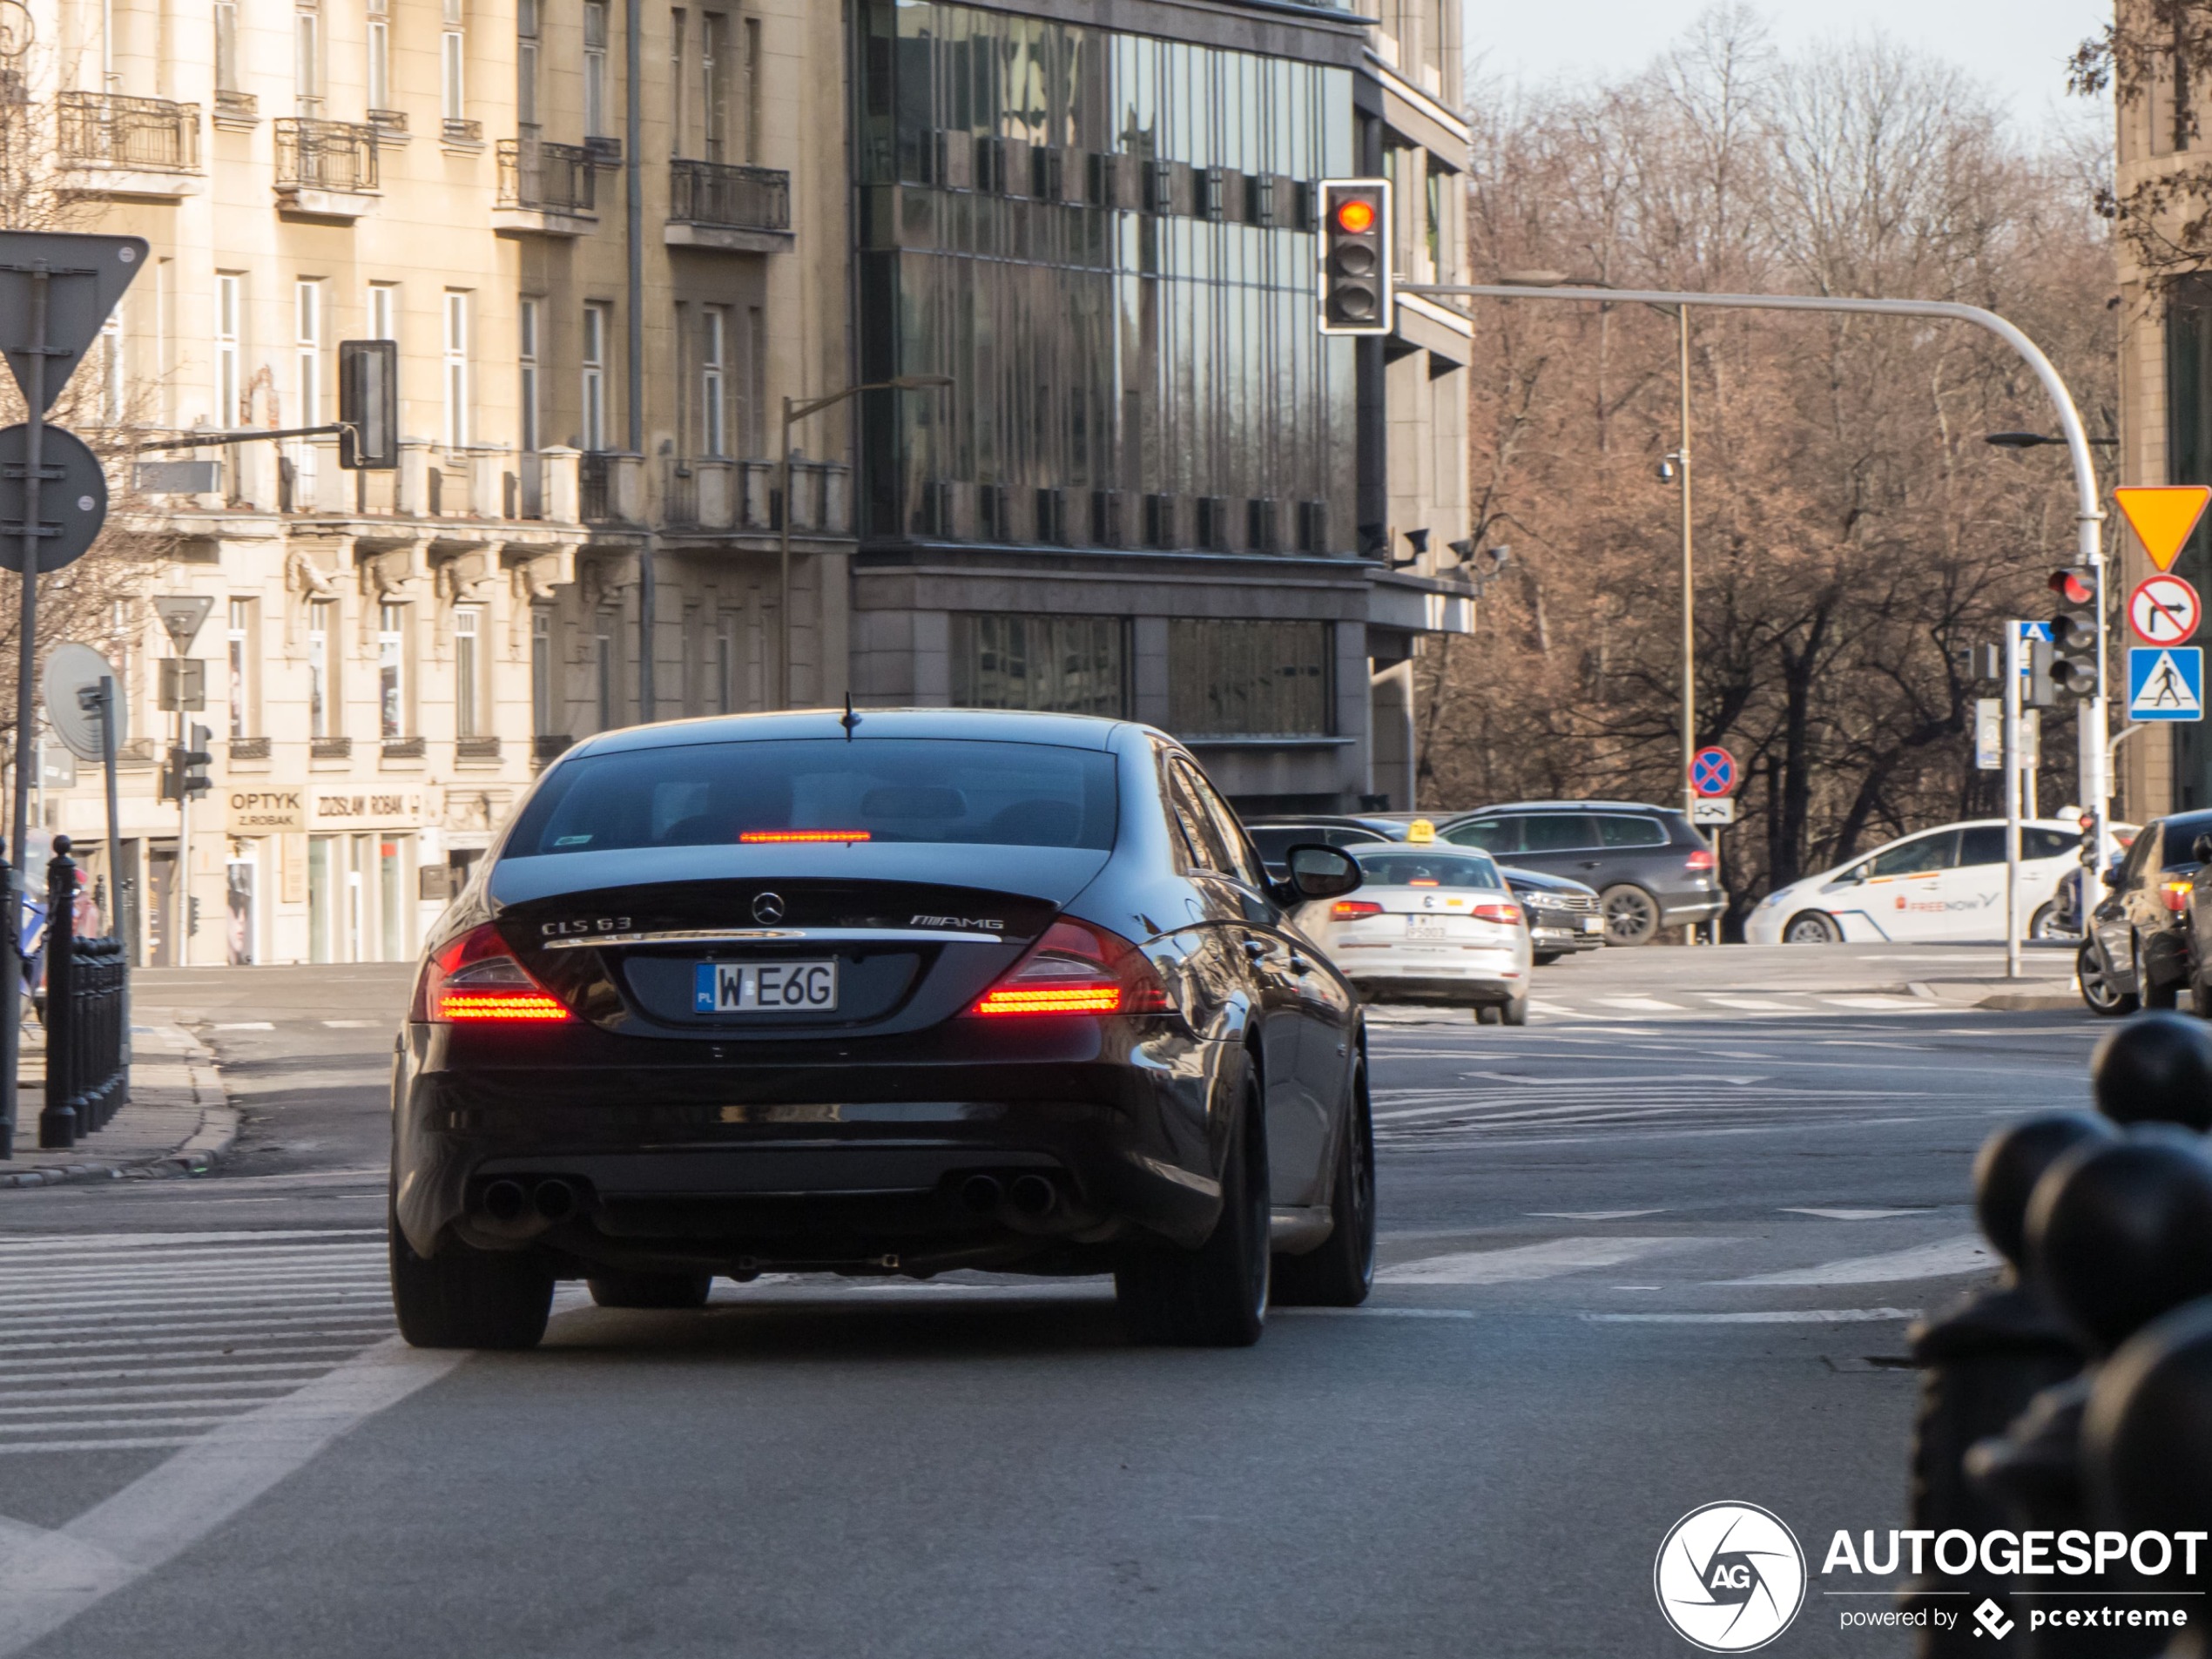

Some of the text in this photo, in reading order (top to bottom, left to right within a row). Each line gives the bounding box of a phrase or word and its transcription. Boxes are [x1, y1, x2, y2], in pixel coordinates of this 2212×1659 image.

[231, 792, 300, 810] OPTYK
[370, 795, 405, 815] ROBAK
[542, 917, 631, 935] CLS 63
[718, 966, 831, 1007] W E6G
[698, 992, 713, 1003] PL
